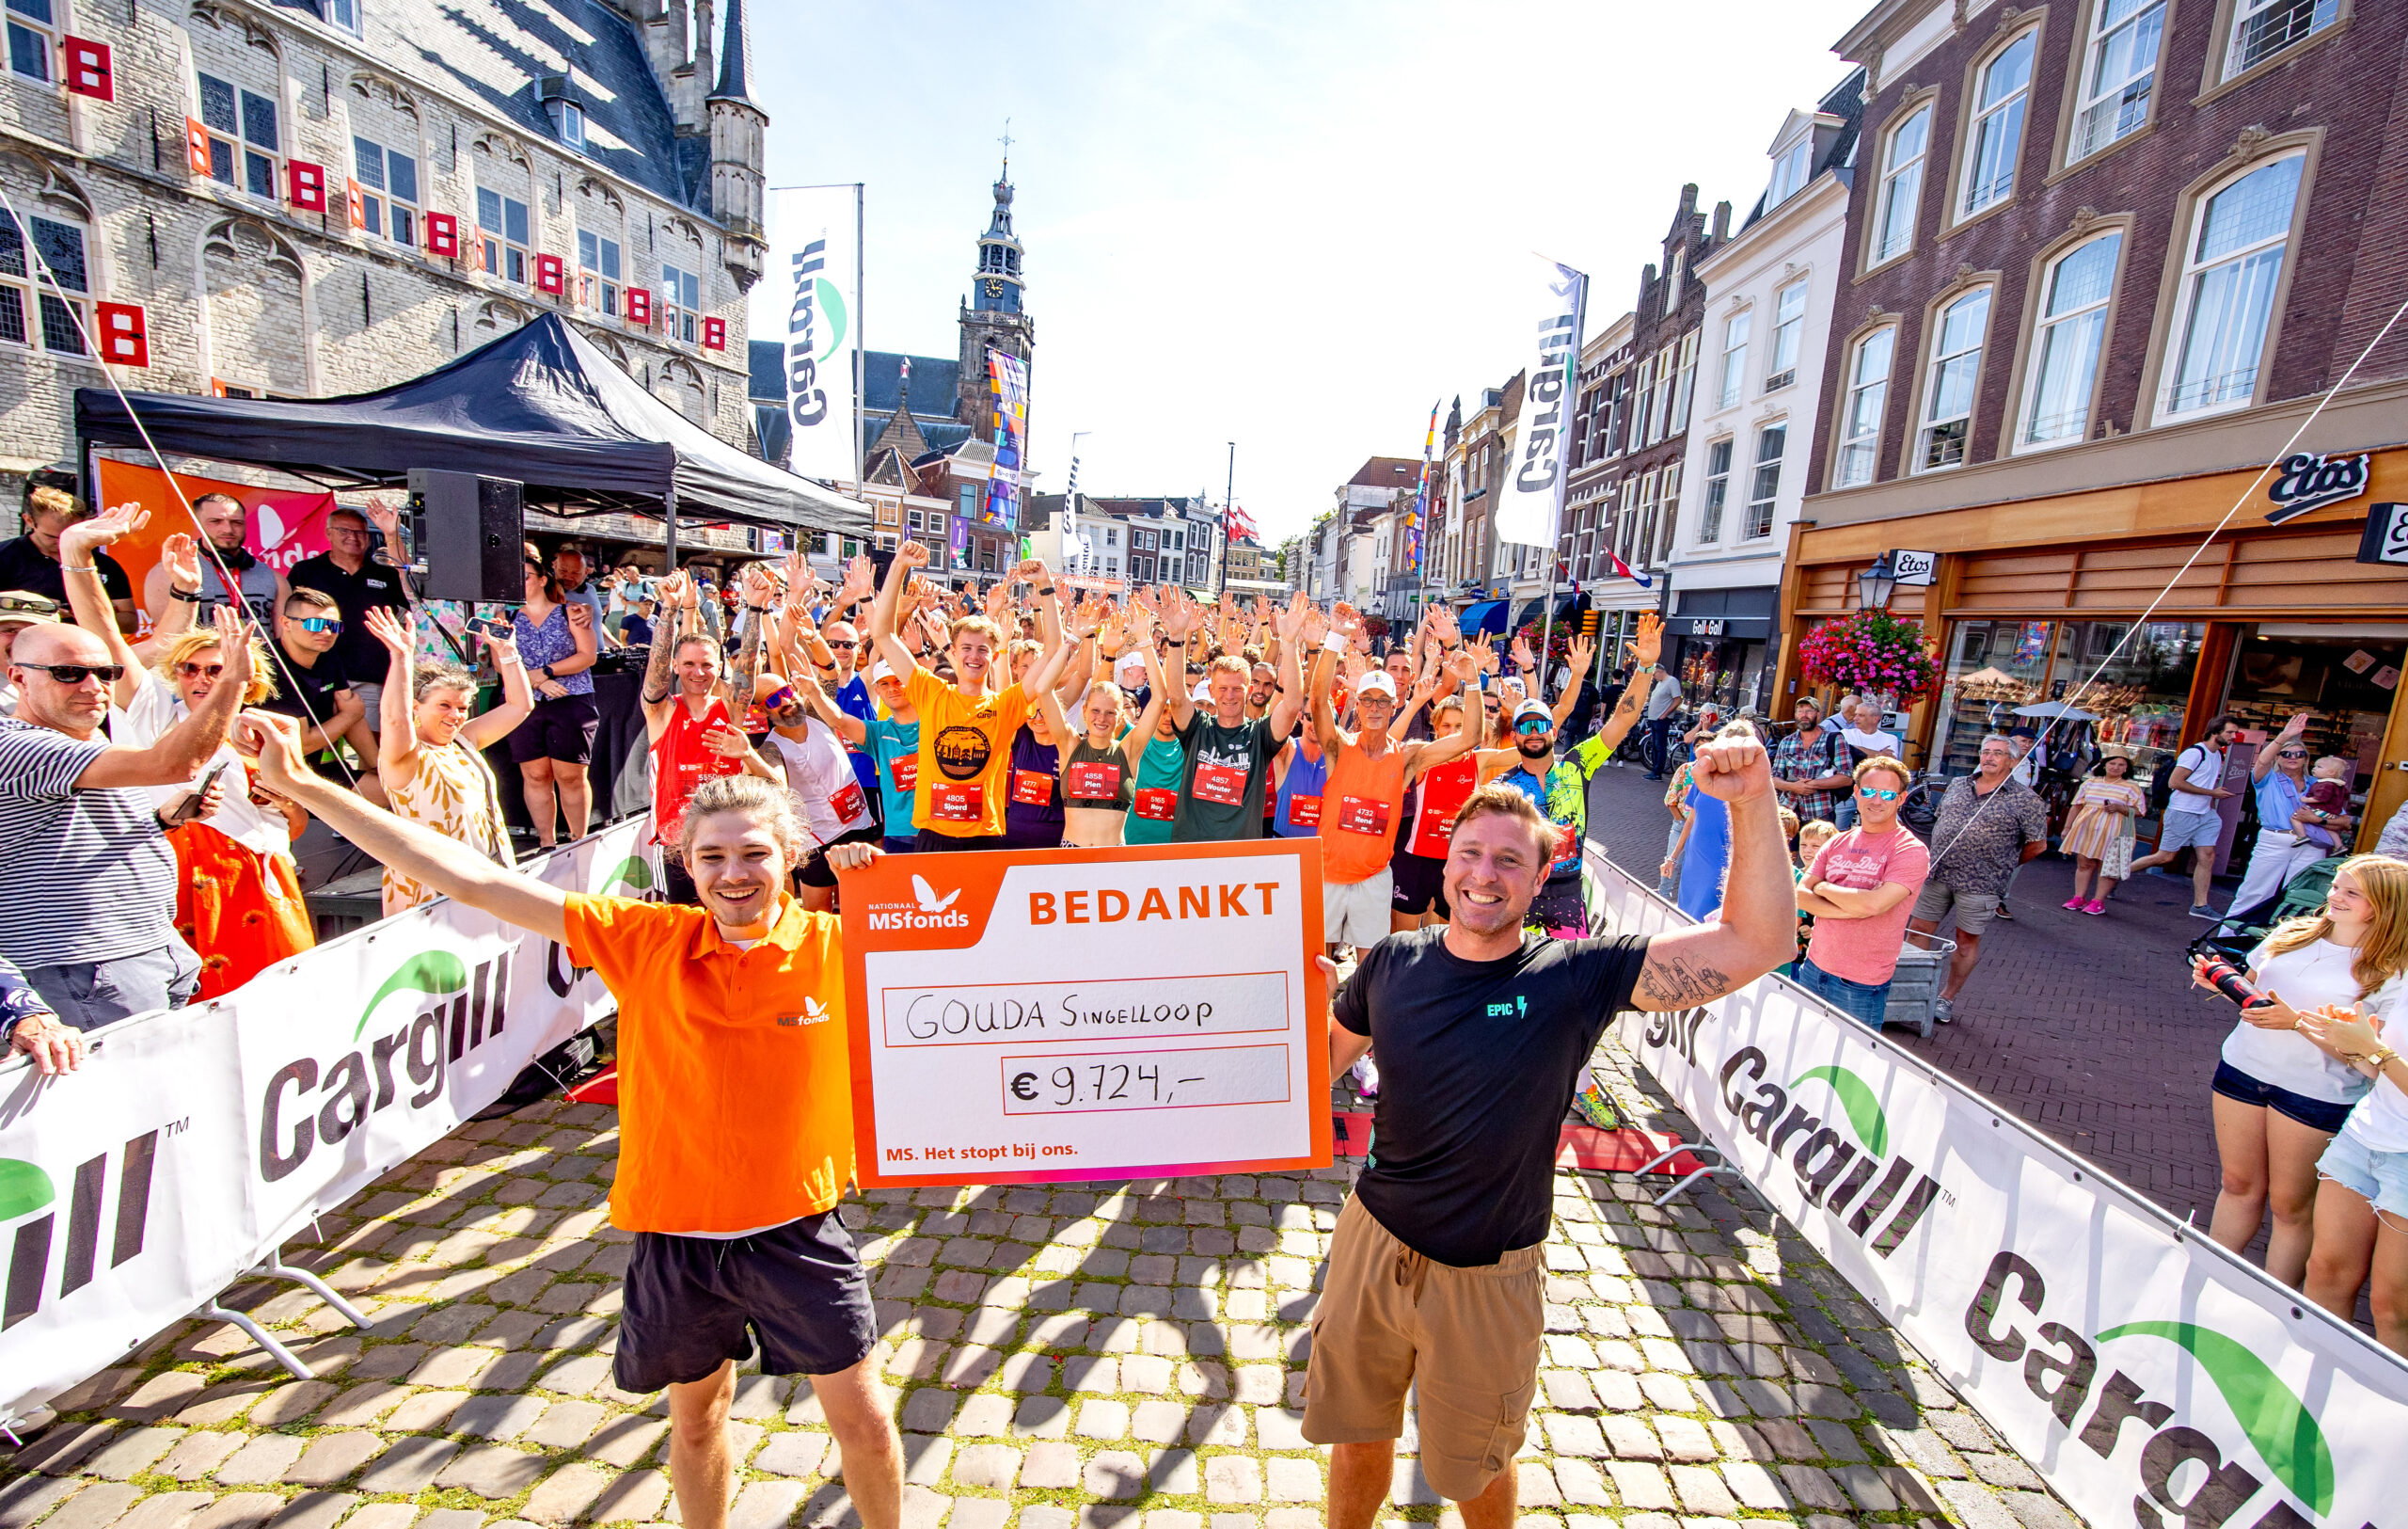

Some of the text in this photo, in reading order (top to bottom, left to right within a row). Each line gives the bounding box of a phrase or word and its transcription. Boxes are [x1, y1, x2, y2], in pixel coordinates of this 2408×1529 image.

[2268, 453, 2367, 503] Etos
[2390, 512, 2408, 543] E
[1898, 554, 1929, 572] Etos
[976, 709, 997, 719] Cargill
[1020, 787, 1037, 795] Petra
[1205, 783, 1231, 793] Wouter
[943, 803, 968, 811] Sjoerd
[945, 794, 966, 803] 4805
[1354, 816, 1373, 825] René
[1356, 808, 1374, 817] 4732
[868, 902, 916, 911] NATIONAAL
[1028, 882, 1280, 926] BEDANKT
[868, 910, 970, 930] MSfonds
[906, 994, 1045, 1040] GOUDA
[1487, 1003, 1513, 1017] EPIC
[777, 1012, 830, 1027] MSfonds
[1646, 1007, 1709, 1069] gill
[260, 953, 514, 1183] Cargill
[886, 1142, 1079, 1161] MS. Het stopt bij ons.
[1719, 1045, 1941, 1260] Cargill
[1965, 1250, 2376, 1529] Carg
